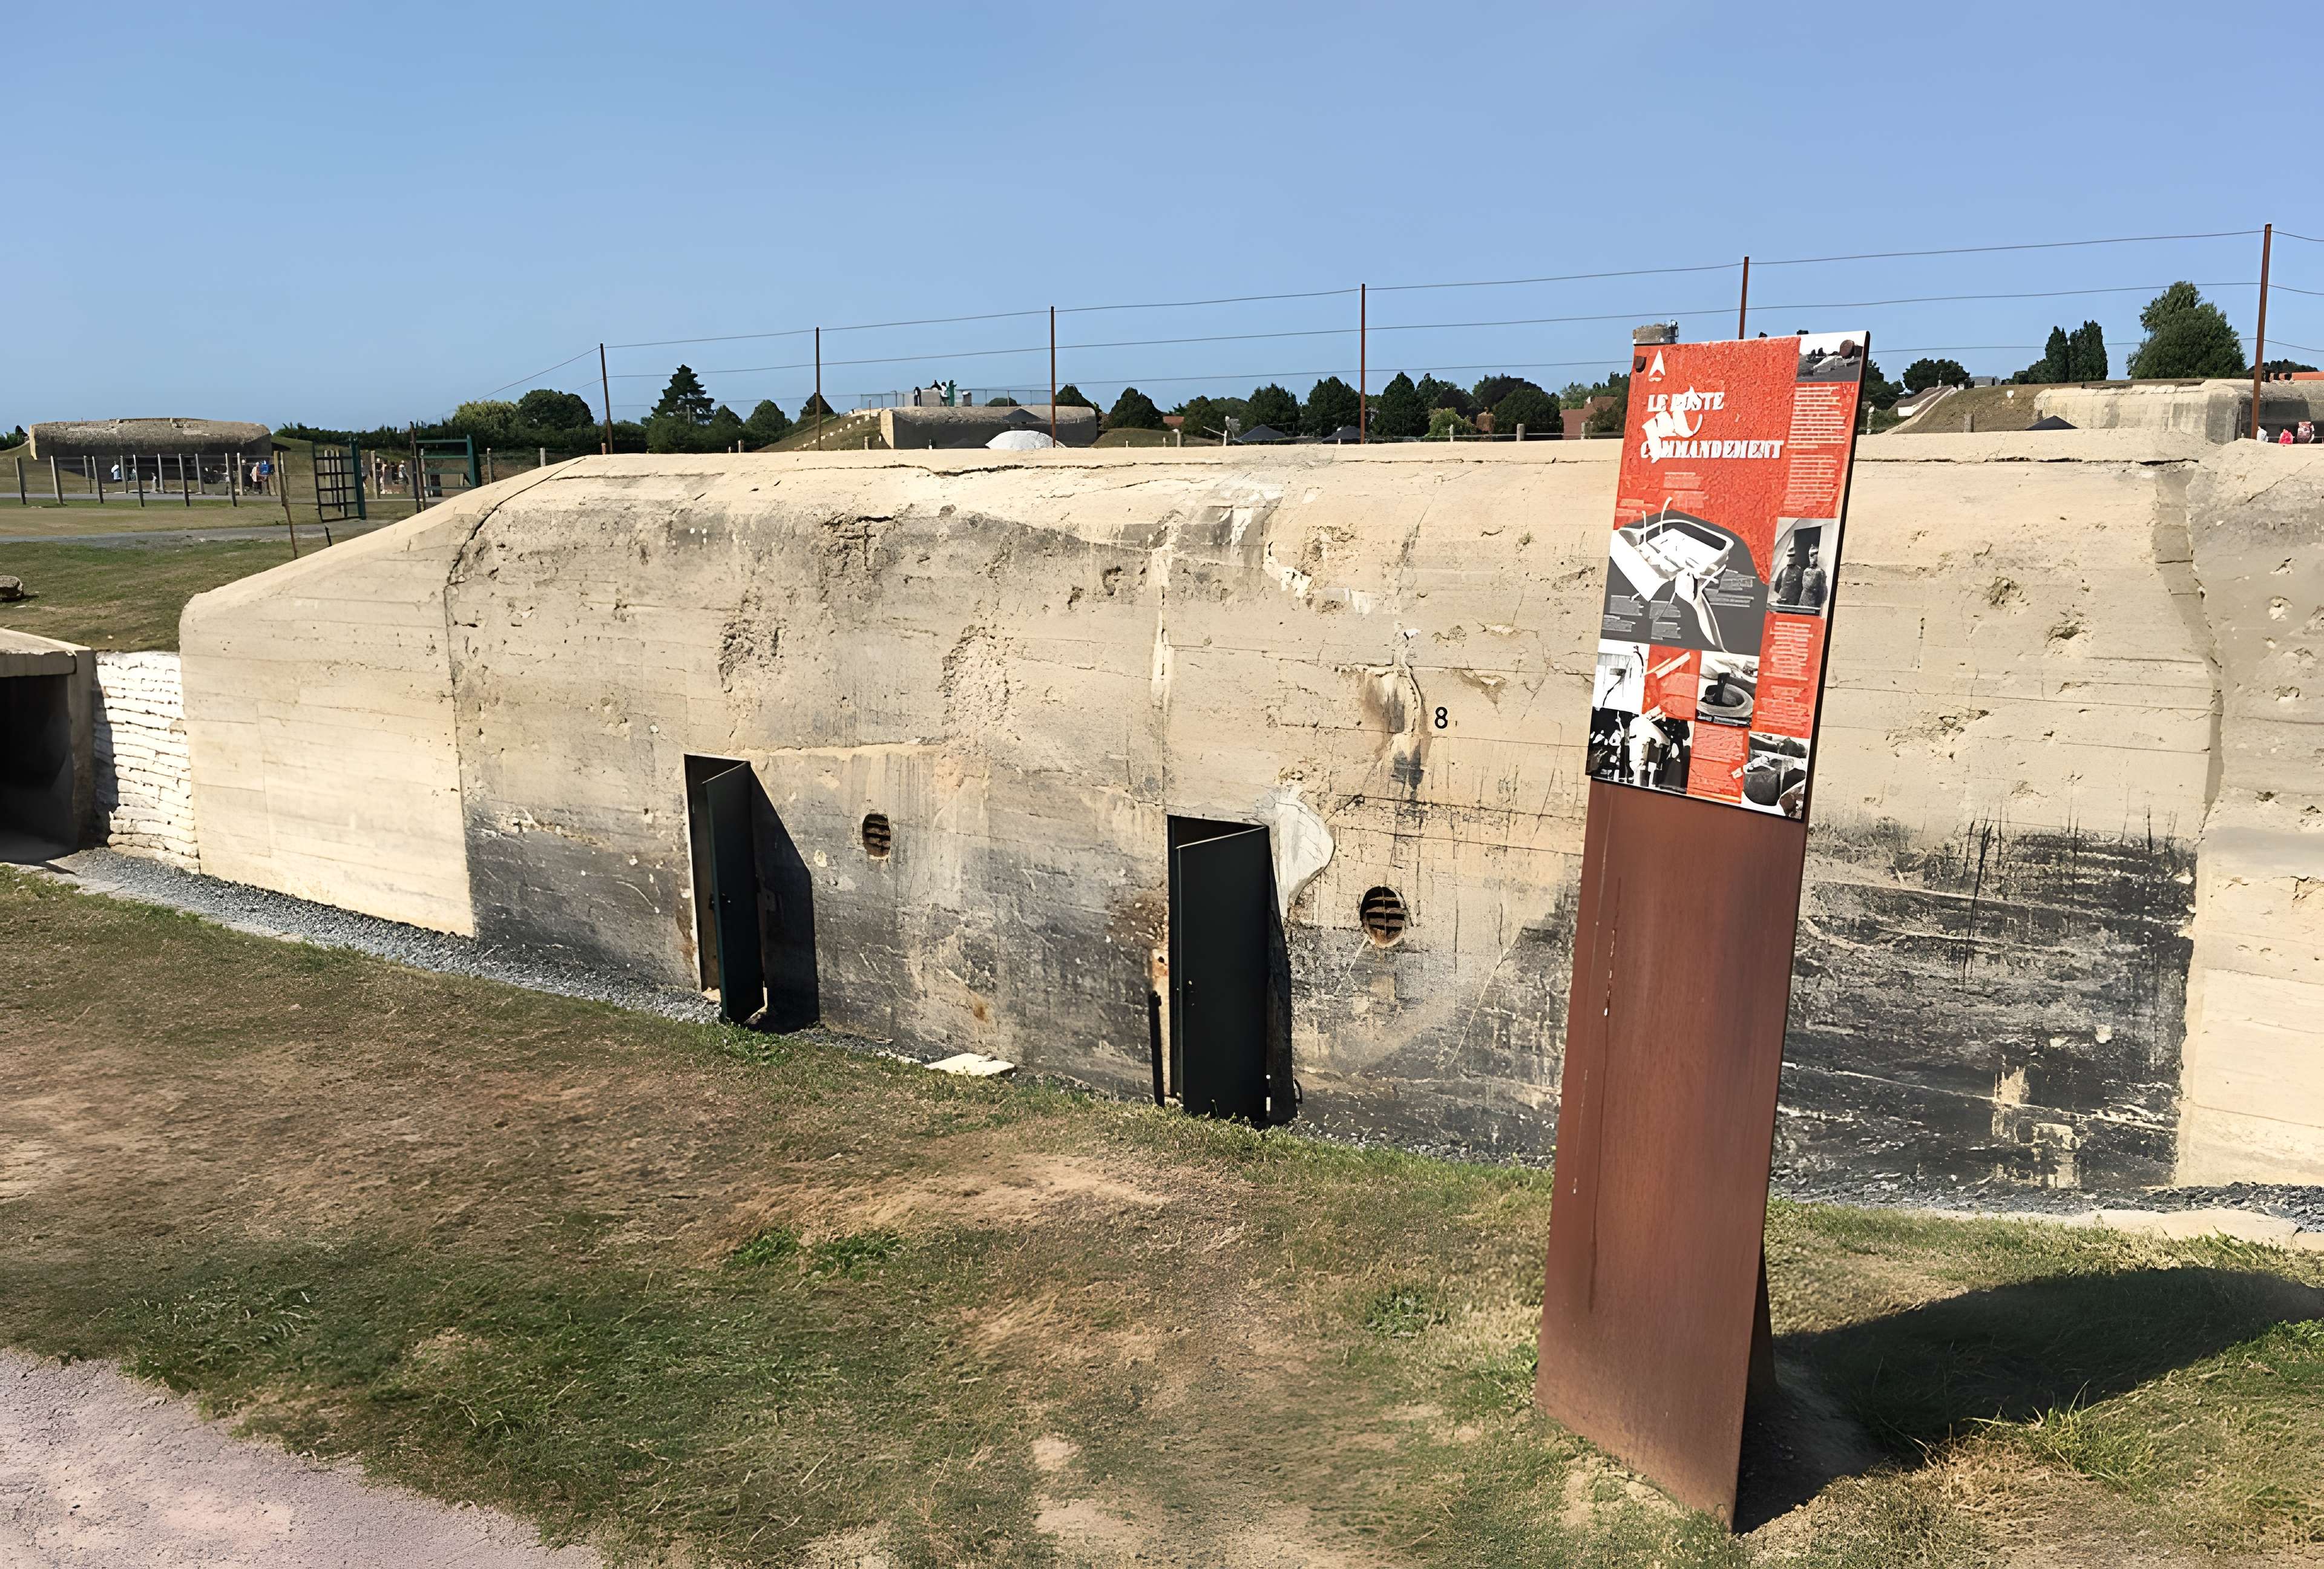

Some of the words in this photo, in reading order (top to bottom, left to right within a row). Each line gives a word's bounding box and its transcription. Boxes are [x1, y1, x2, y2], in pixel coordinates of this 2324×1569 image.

[1647, 393, 1669, 412] LE
[1641, 439, 1785, 458] CMMANDEMENT
[1435, 706, 1448, 729] 8
